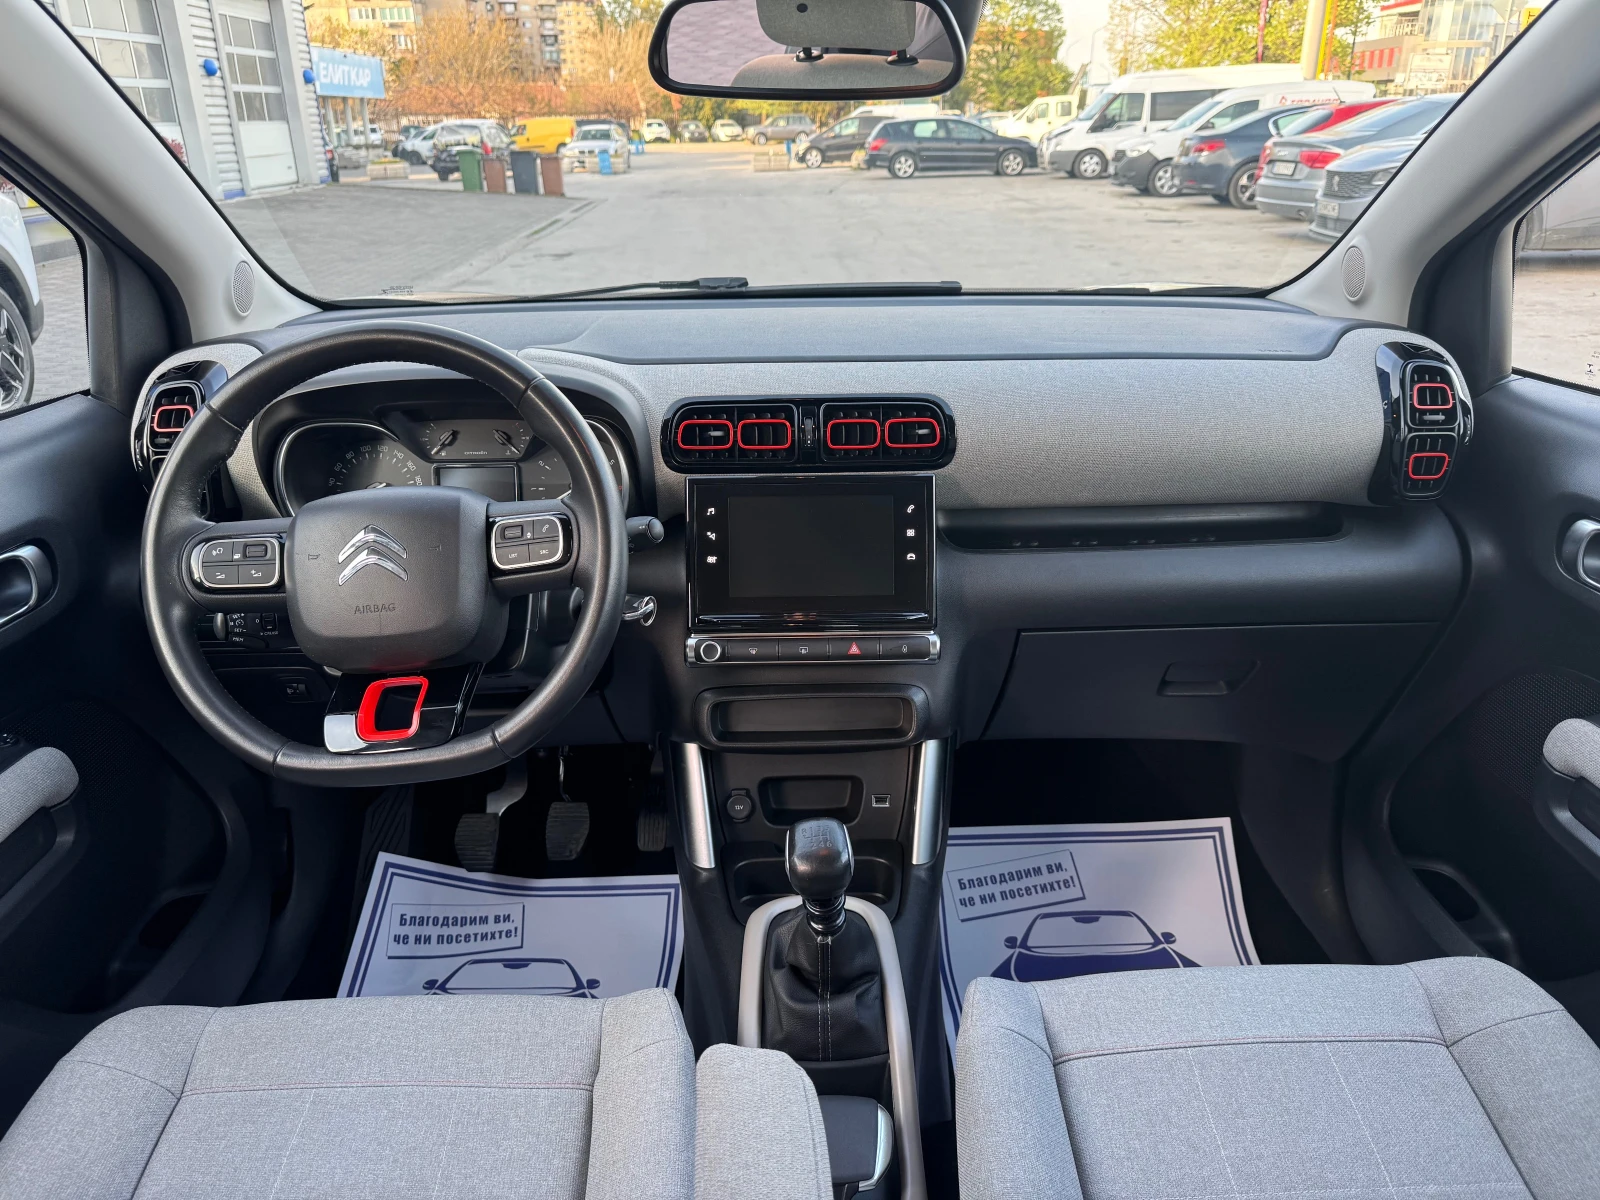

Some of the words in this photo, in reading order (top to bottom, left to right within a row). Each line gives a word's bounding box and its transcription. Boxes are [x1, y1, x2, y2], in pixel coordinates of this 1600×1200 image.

[319, 61, 349, 86] ЕЛИТ
[350, 66, 371, 87] КАР
[333, 462, 343, 472] 60
[345, 450, 355, 460] 80
[377, 444, 388, 452] 120
[393, 449, 404, 460] 140
[406, 460, 417, 472] 160
[415, 475, 423, 486] 180
[354, 603, 396, 615] AIRBAG
[957, 866, 1043, 891] Благодарим
[1046, 861, 1068, 875] ви,
[959, 896, 976, 908] че
[978, 892, 997, 905] ни
[1000, 875, 1076, 901] посетихте!
[399, 913, 489, 928] Благодарим
[493, 913, 515, 924] ви,
[393, 933, 410, 945] че
[414, 933, 432, 945] ни
[436, 926, 518, 945] посетихте!
